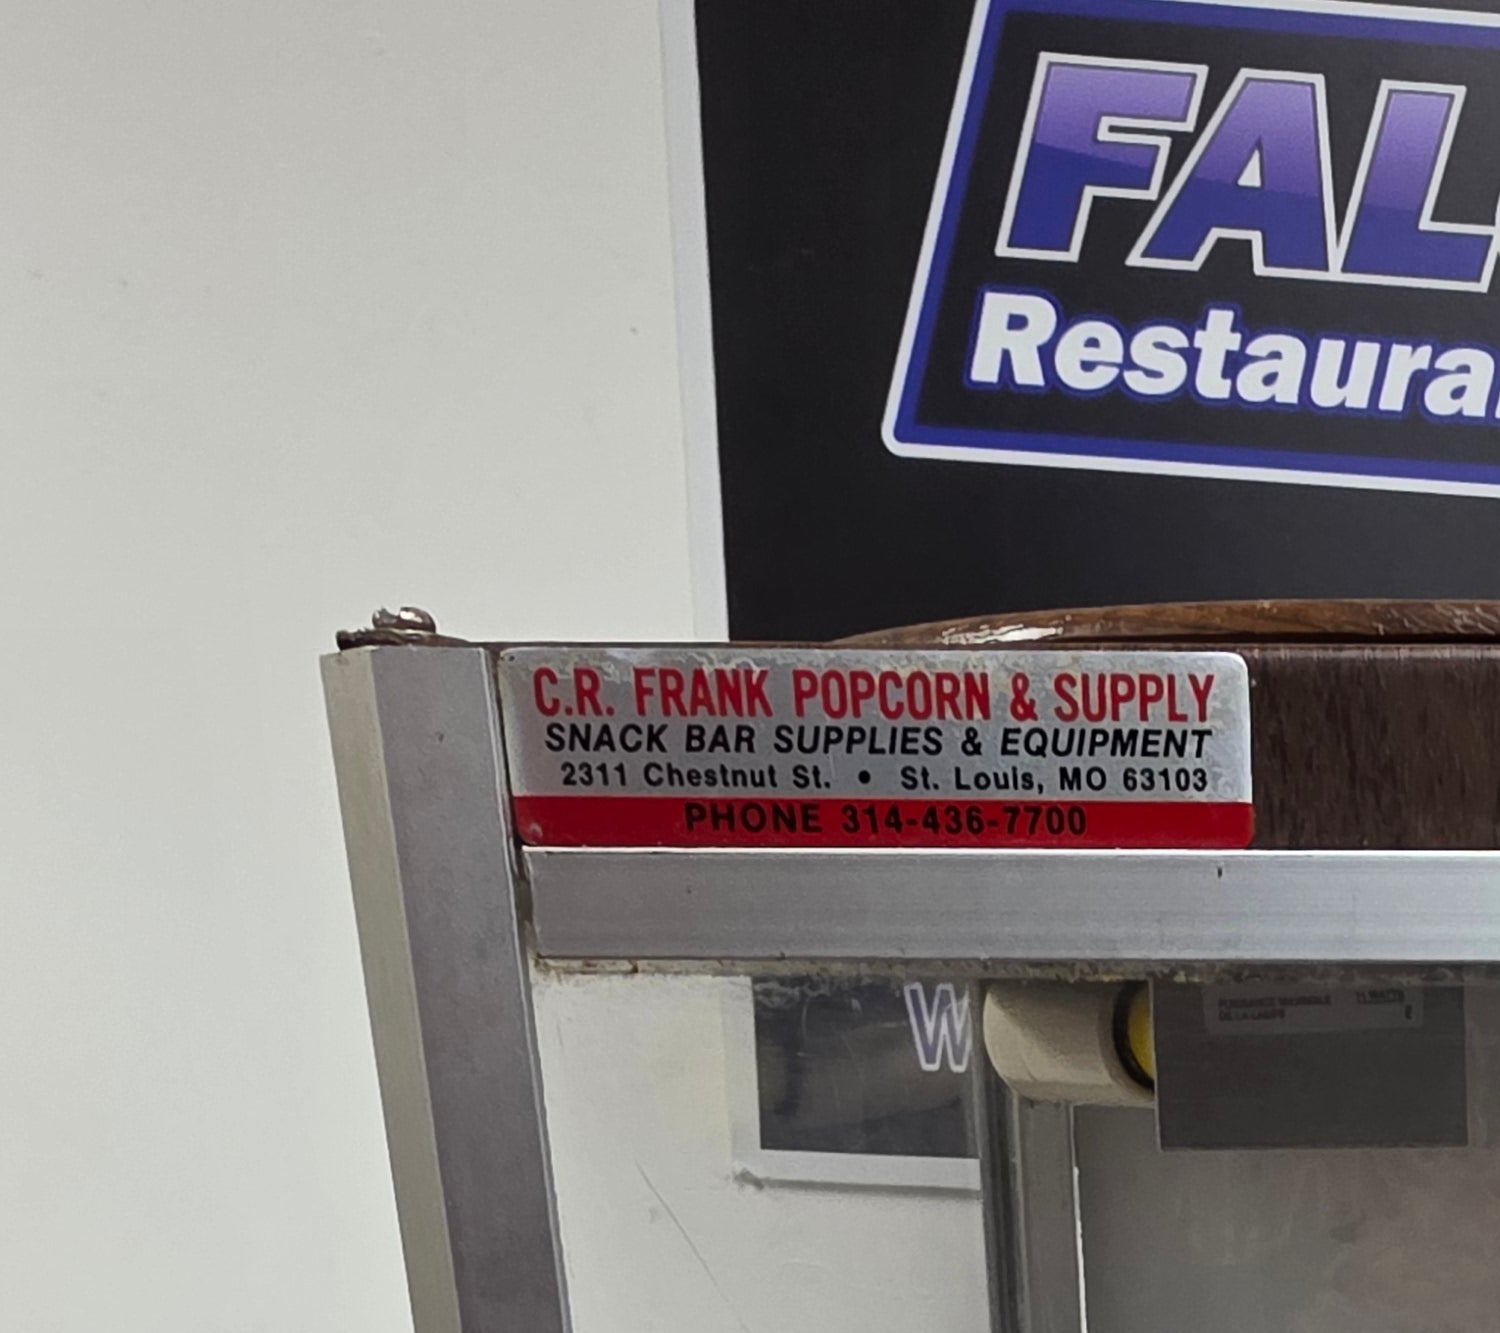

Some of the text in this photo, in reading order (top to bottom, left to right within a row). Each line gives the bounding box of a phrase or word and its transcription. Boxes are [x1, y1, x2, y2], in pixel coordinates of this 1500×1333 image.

[533, 666, 1215, 723] C.R. FRANK POPCORN & SUPPLY
[545, 722, 1213, 758] SNACK BAR SUPPLIES & EQUIPMENT
[560, 762, 1208, 794] 2311 Chestnut St. St. Louis, MO 63103
[685, 803, 1087, 835] PHONE 314-436-7700
